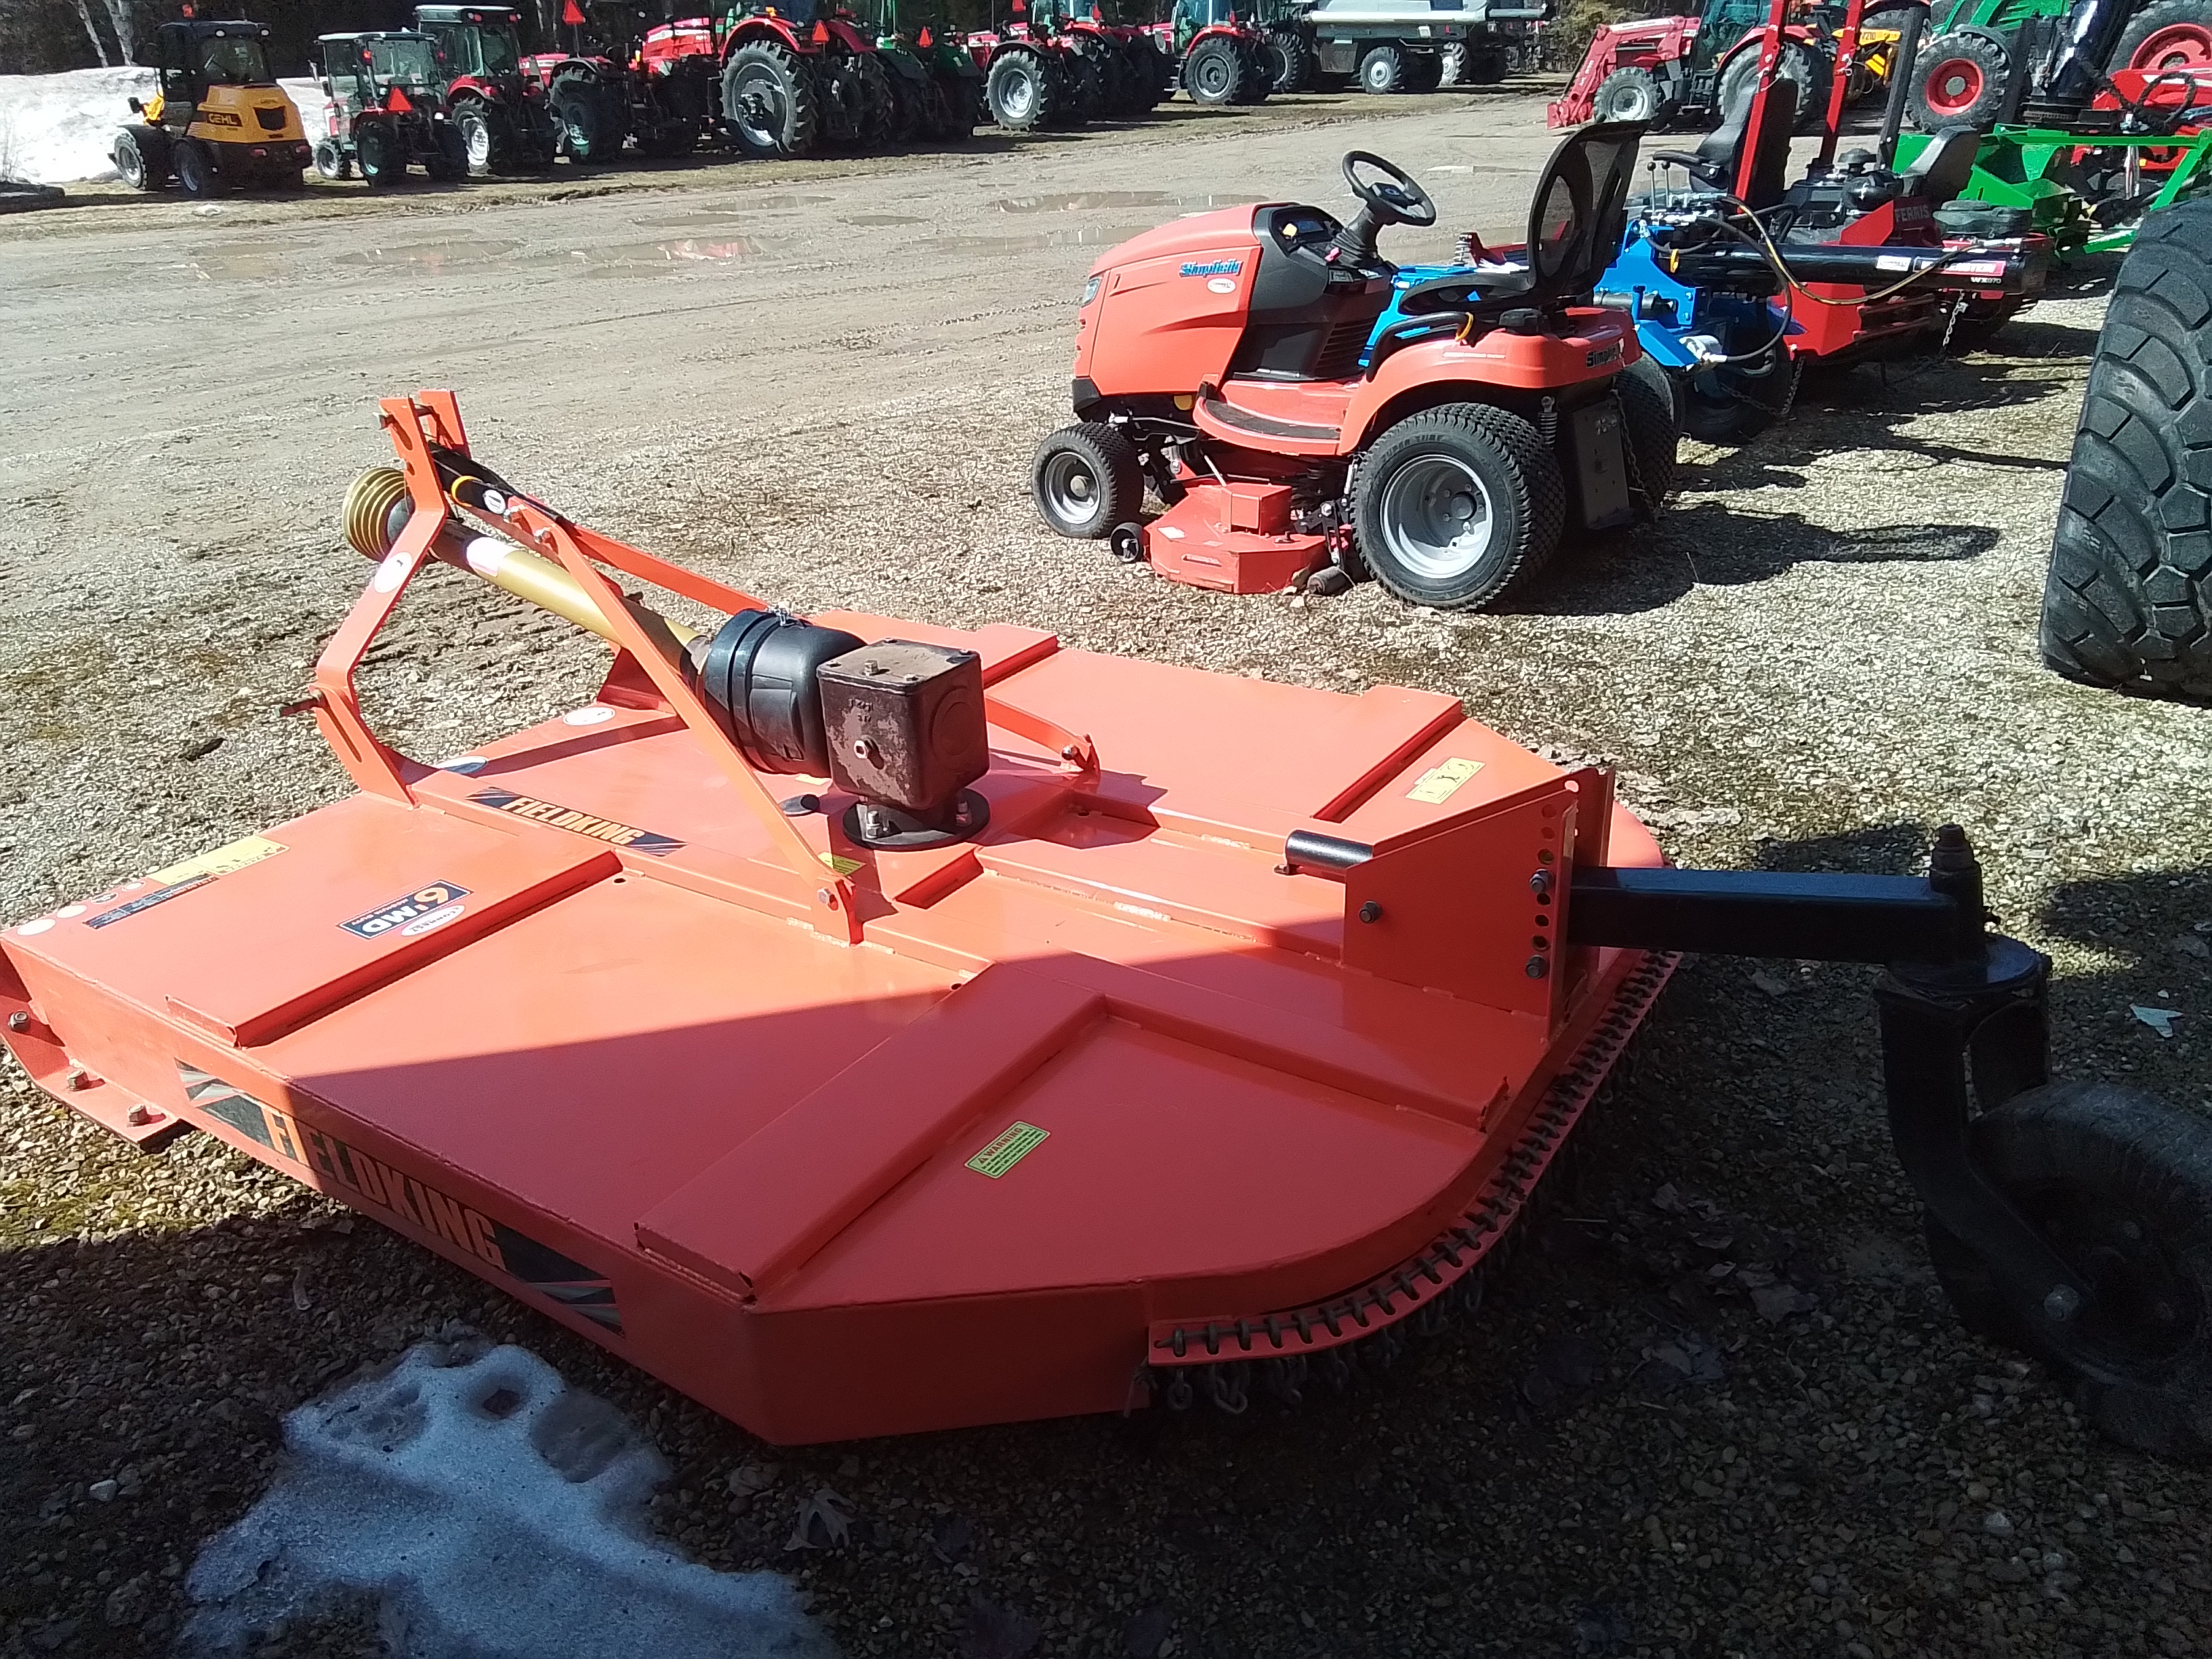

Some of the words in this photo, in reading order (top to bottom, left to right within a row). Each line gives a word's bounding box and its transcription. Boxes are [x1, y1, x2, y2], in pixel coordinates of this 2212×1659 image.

[208, 113, 238, 125] GEHL
[1895, 204, 1930, 223] FERRIS
[1414, 434, 1444, 442] TURF
[499, 796, 646, 846] FIELDKING
[983, 1126, 1025, 1158] WARNING
[260, 1105, 507, 1272] FIELDKING
